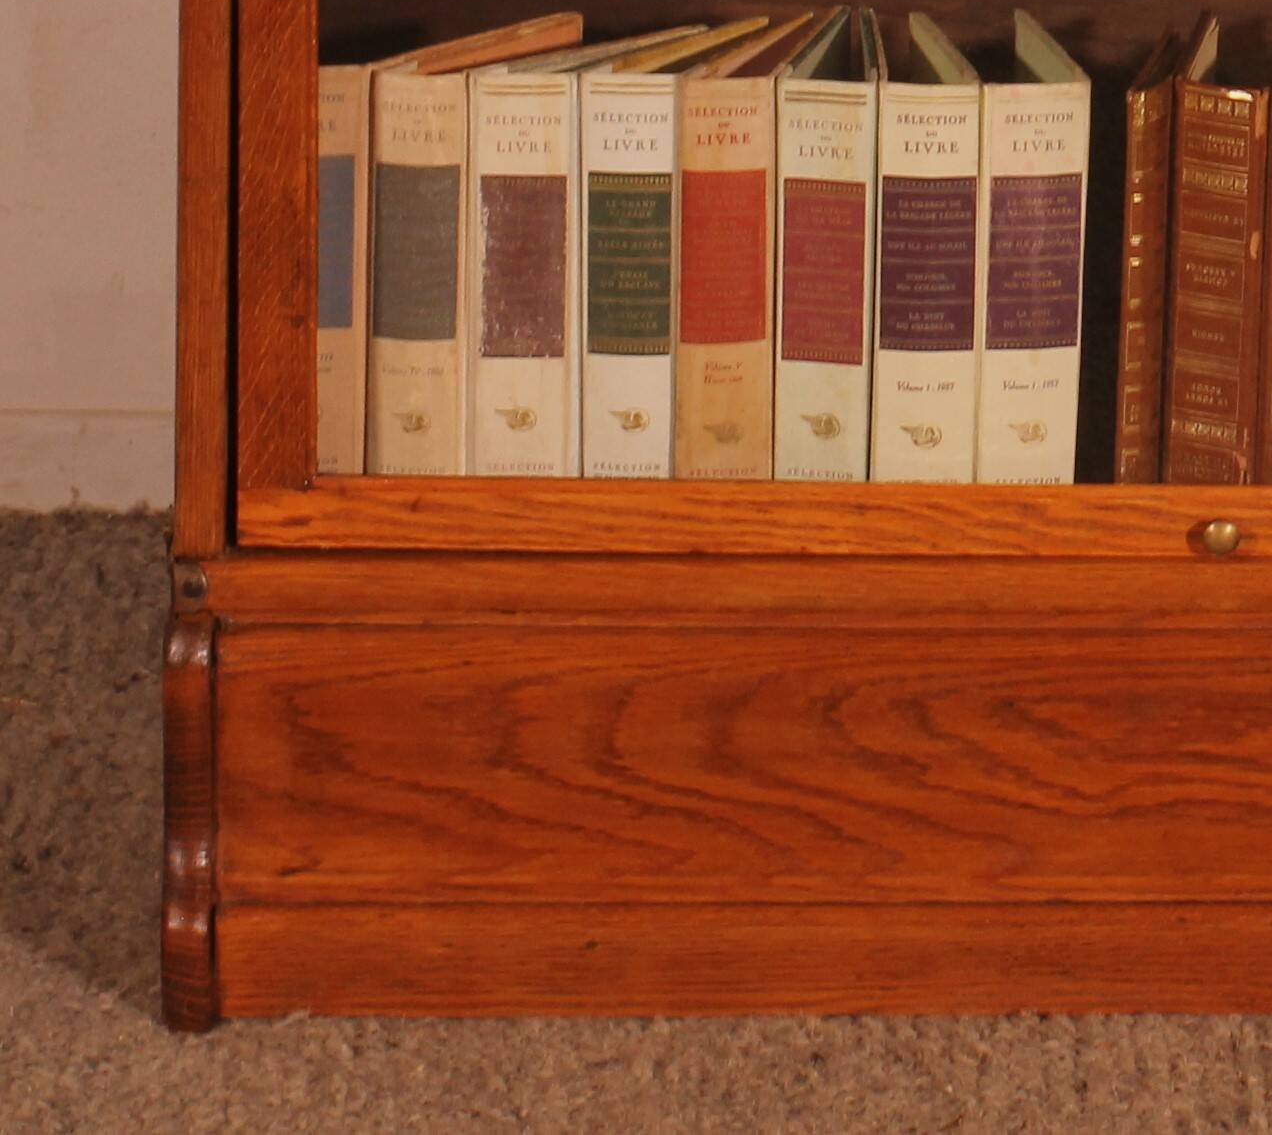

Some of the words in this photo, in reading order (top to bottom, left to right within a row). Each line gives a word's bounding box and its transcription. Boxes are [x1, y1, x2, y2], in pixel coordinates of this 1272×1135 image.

[603, 139, 659, 151] LIVRE
[697, 133, 751, 145] LIVRE
[1012, 139, 1066, 152] LIVRE
[496, 141, 552, 154] LIVRE
[800, 146, 854, 160] LIVRE
[904, 141, 959, 154] LIVRE
